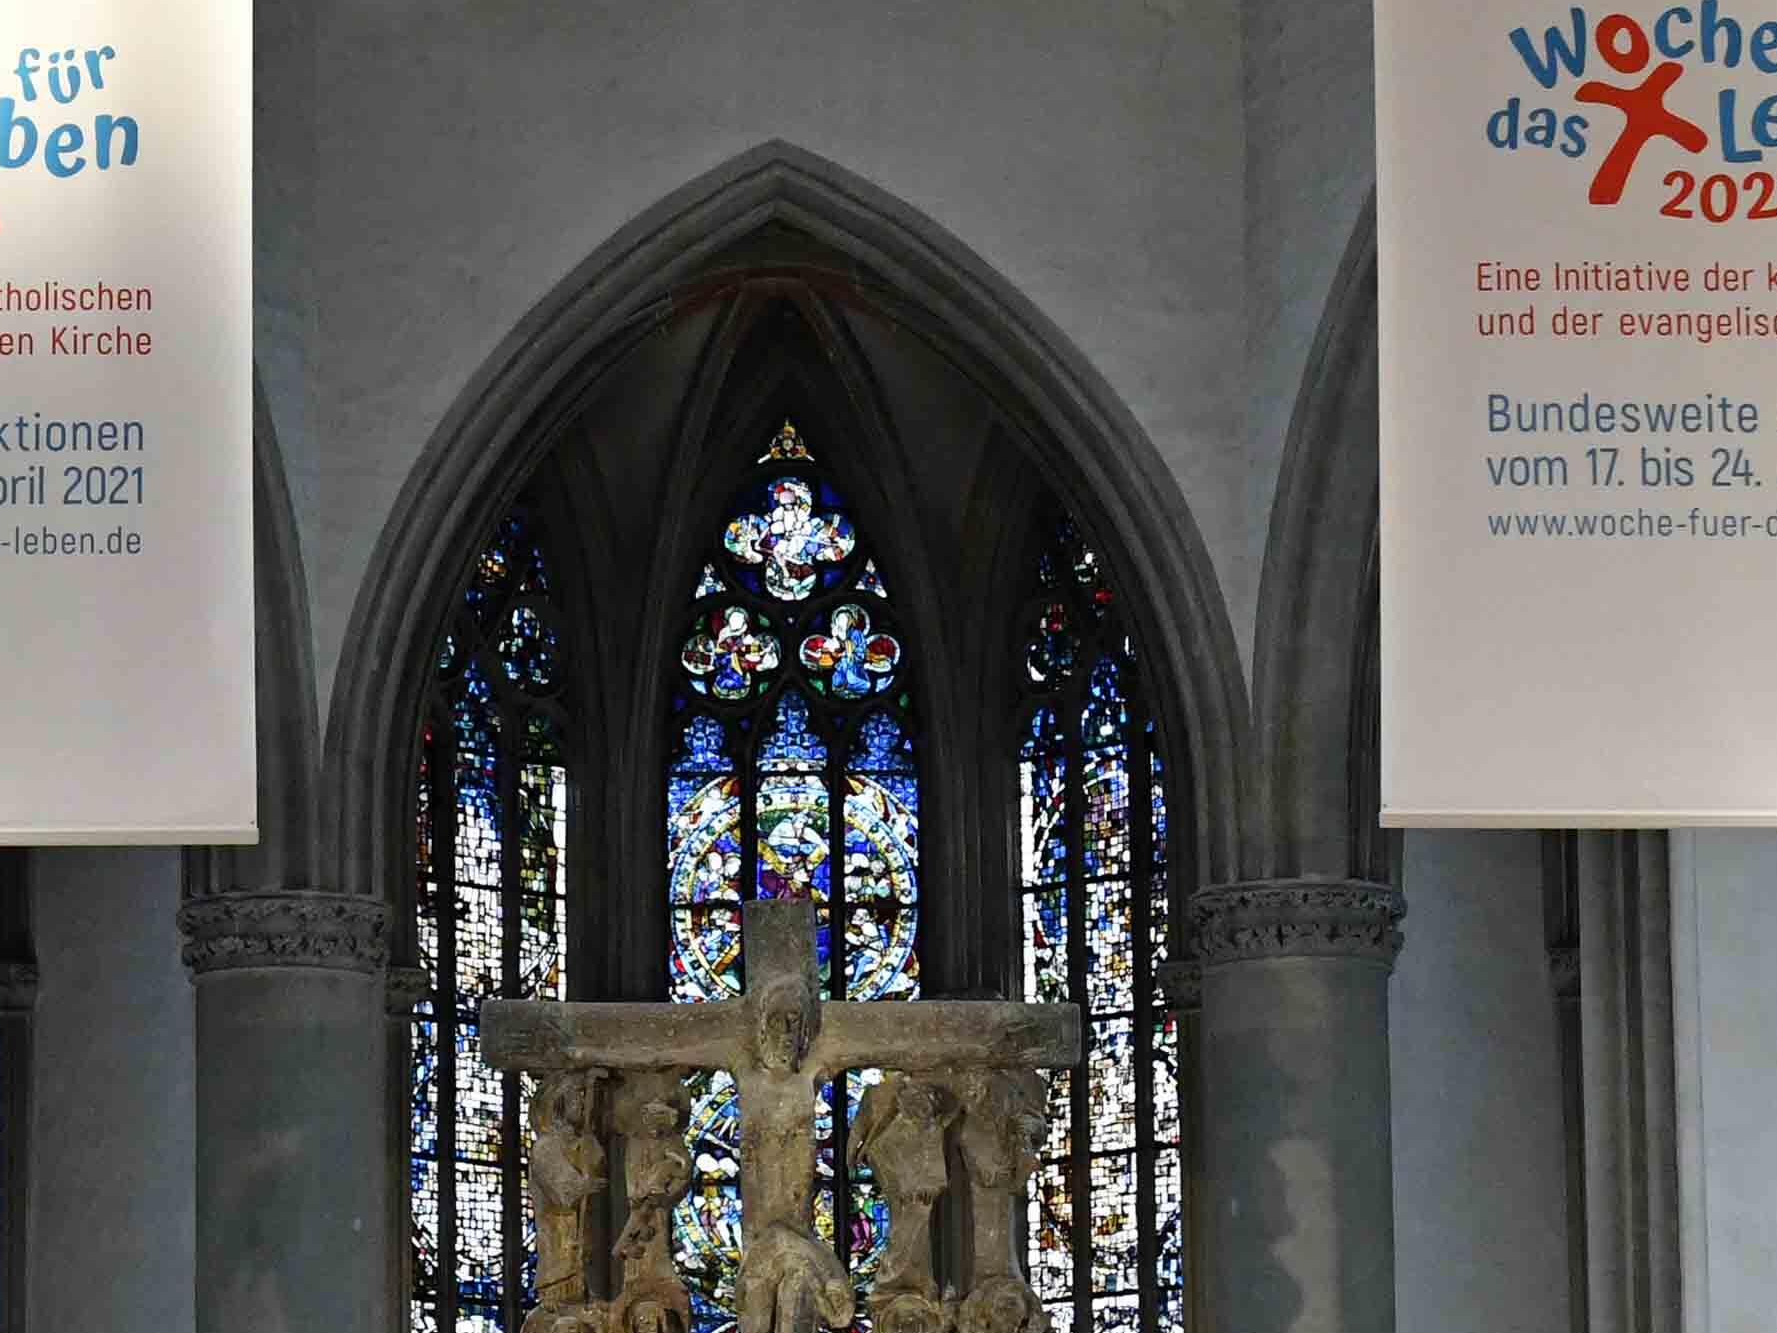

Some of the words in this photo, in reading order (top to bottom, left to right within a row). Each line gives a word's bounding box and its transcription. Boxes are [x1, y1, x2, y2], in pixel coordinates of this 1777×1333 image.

[13, 44, 116, 104] für
[1486, 96, 1590, 158] das
[1478, 262, 1540, 291] Eine
[1555, 261, 1690, 292] Initiative
[1704, 262, 1754, 291] der
[52, 325, 151, 355] Kirche
[1479, 305, 1534, 336] und
[1552, 306, 1603, 335] der
[1488, 392, 1758, 433] Bundesweite
[63, 466, 142, 504] 2021
[1486, 456, 1567, 486] vom
[1586, 448, 1624, 486] 17.
[1641, 447, 1694, 487] bis
[1712, 448, 1762, 486] 24.
